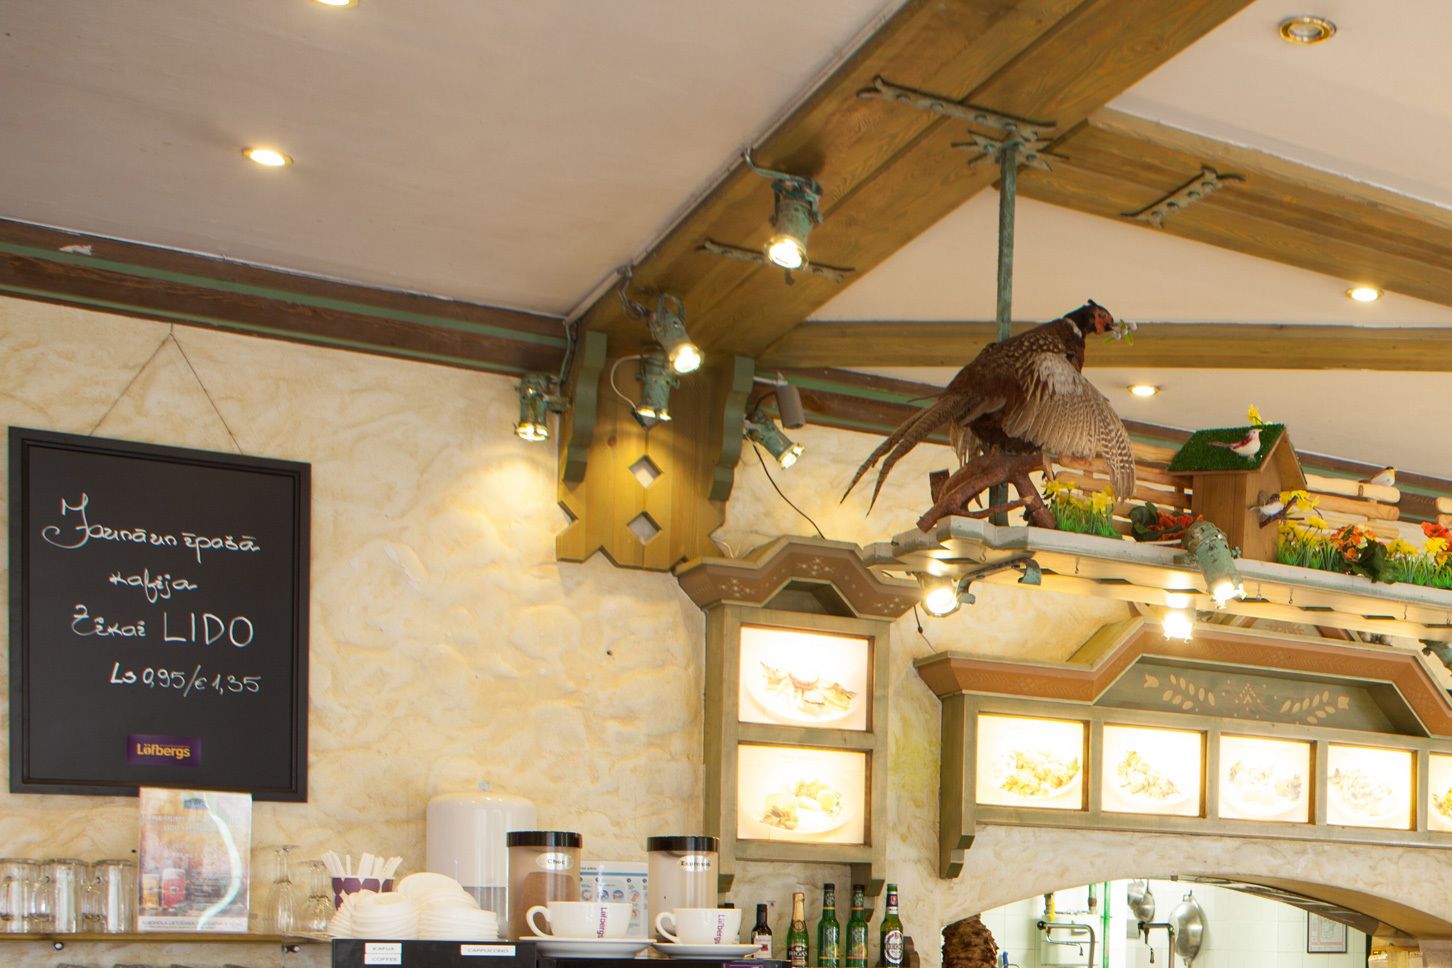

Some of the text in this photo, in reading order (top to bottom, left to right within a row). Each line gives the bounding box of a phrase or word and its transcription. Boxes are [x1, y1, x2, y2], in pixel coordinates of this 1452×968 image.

[42, 492, 147, 549] Jaunā
[108, 567, 198, 604] kafija
[163, 611, 254, 648] LIDO
[110, 661, 138, 684] Ls
[136, 743, 191, 760] Löfbergs
